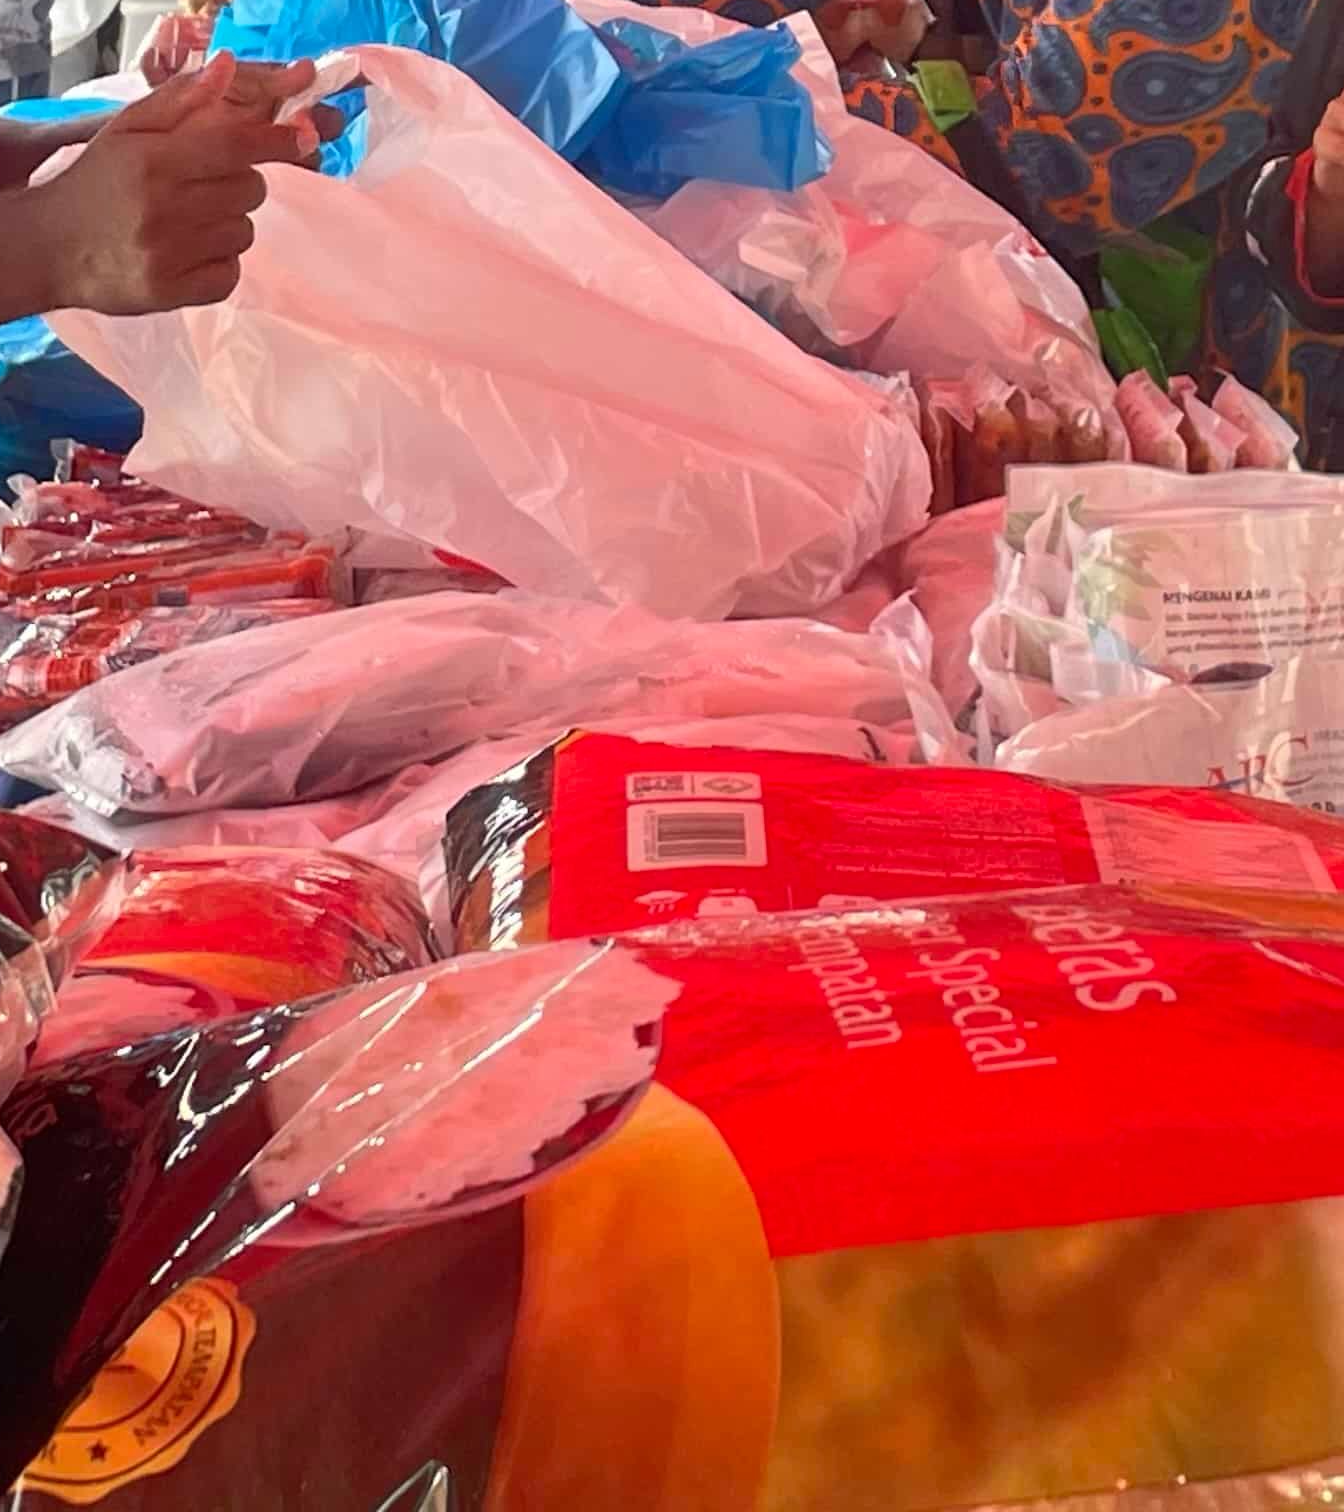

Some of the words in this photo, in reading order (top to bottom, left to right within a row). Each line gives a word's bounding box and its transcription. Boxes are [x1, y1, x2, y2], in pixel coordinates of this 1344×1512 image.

[786, 924, 903, 1050] empatan
[905, 947, 1058, 1073] Special
[133, 1327, 217, 1445] TEMPATAN
